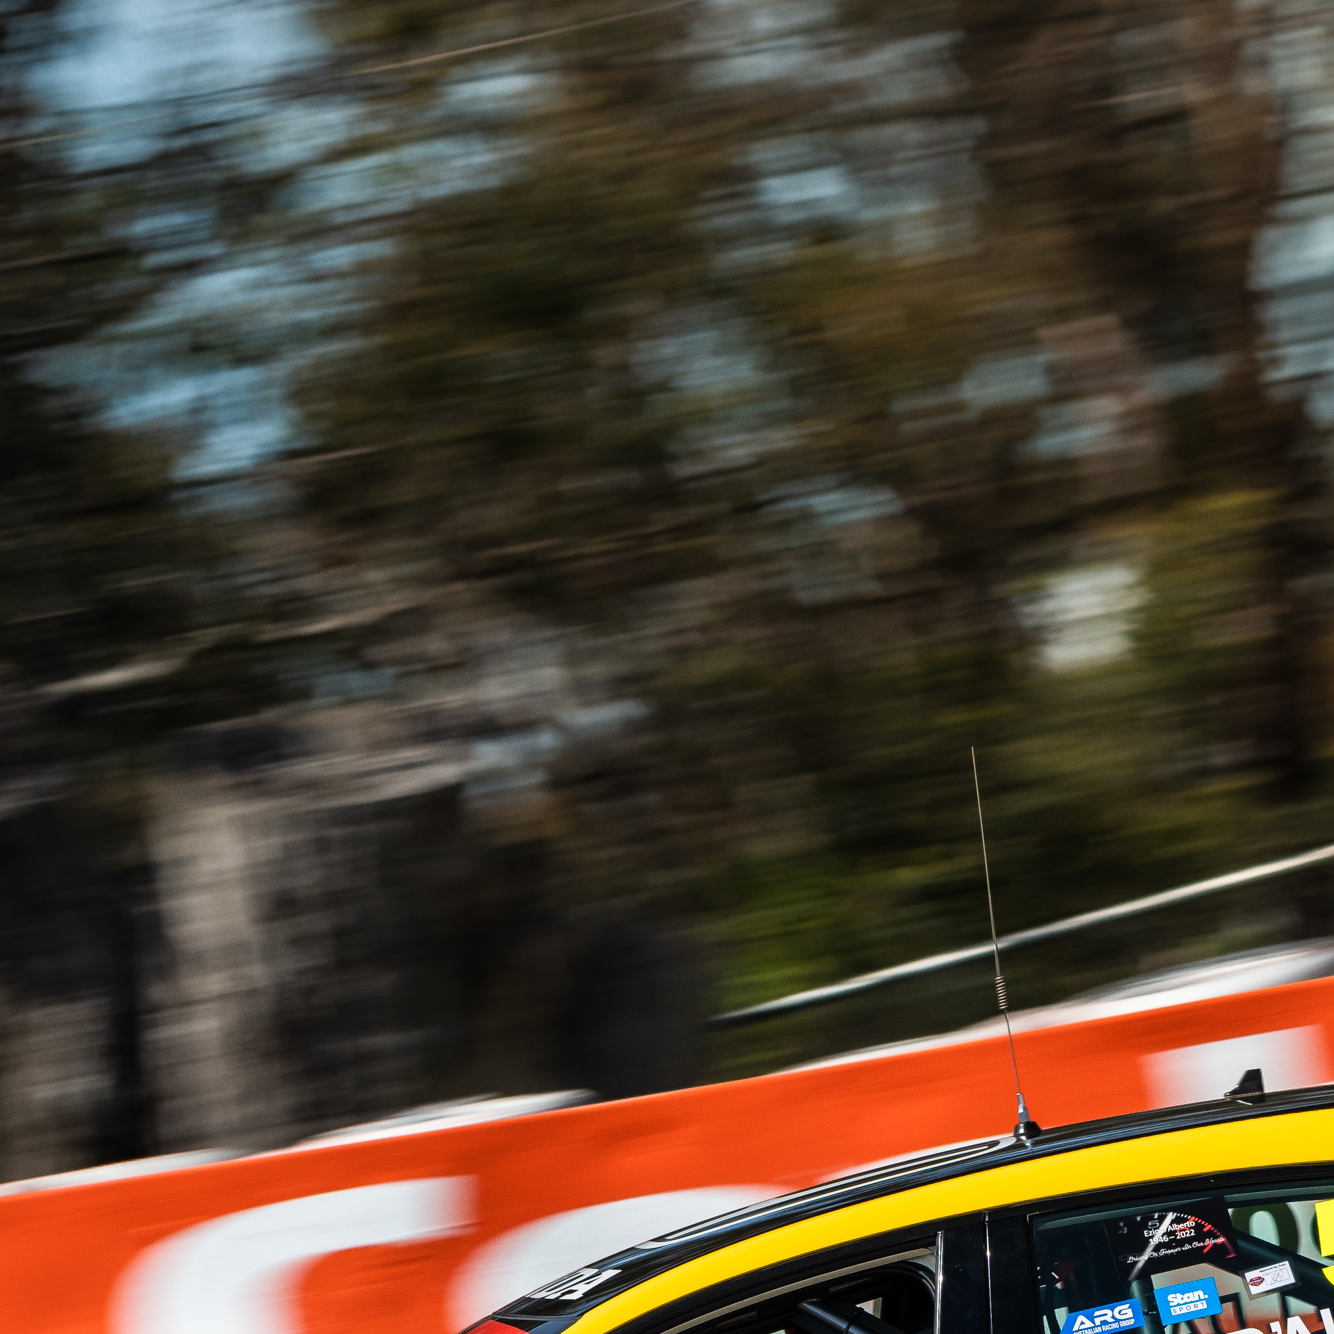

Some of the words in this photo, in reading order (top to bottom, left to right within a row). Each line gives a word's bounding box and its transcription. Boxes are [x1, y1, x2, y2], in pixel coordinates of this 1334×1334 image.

[1167, 1289, 1209, 1307] Stan.
[1171, 1301, 1206, 1315] SPORT
[1072, 1303, 1134, 1332] ARG
[1102, 1321, 1119, 1333] RACING
[1119, 1318, 1136, 1329] GROUP
